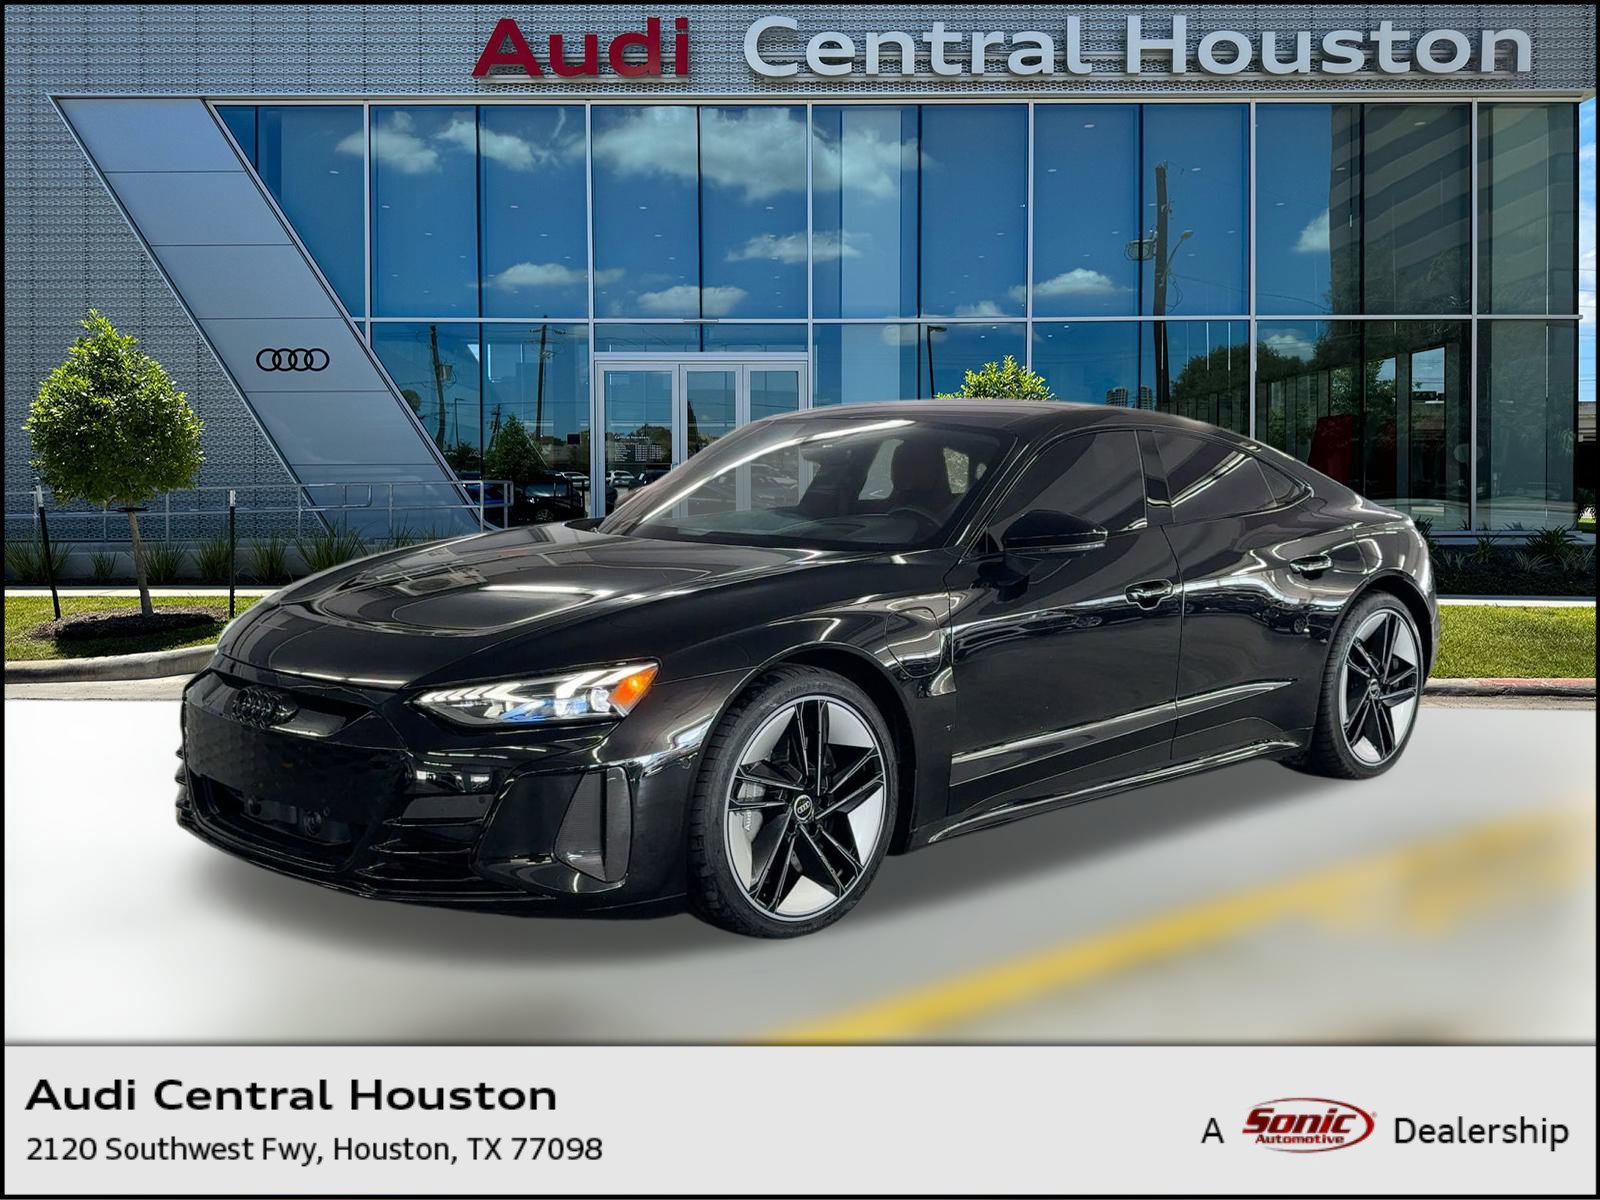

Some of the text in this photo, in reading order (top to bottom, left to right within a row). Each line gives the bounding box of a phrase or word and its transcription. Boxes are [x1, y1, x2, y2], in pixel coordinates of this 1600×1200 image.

[471, 15, 1532, 78] Audi Central Houston
